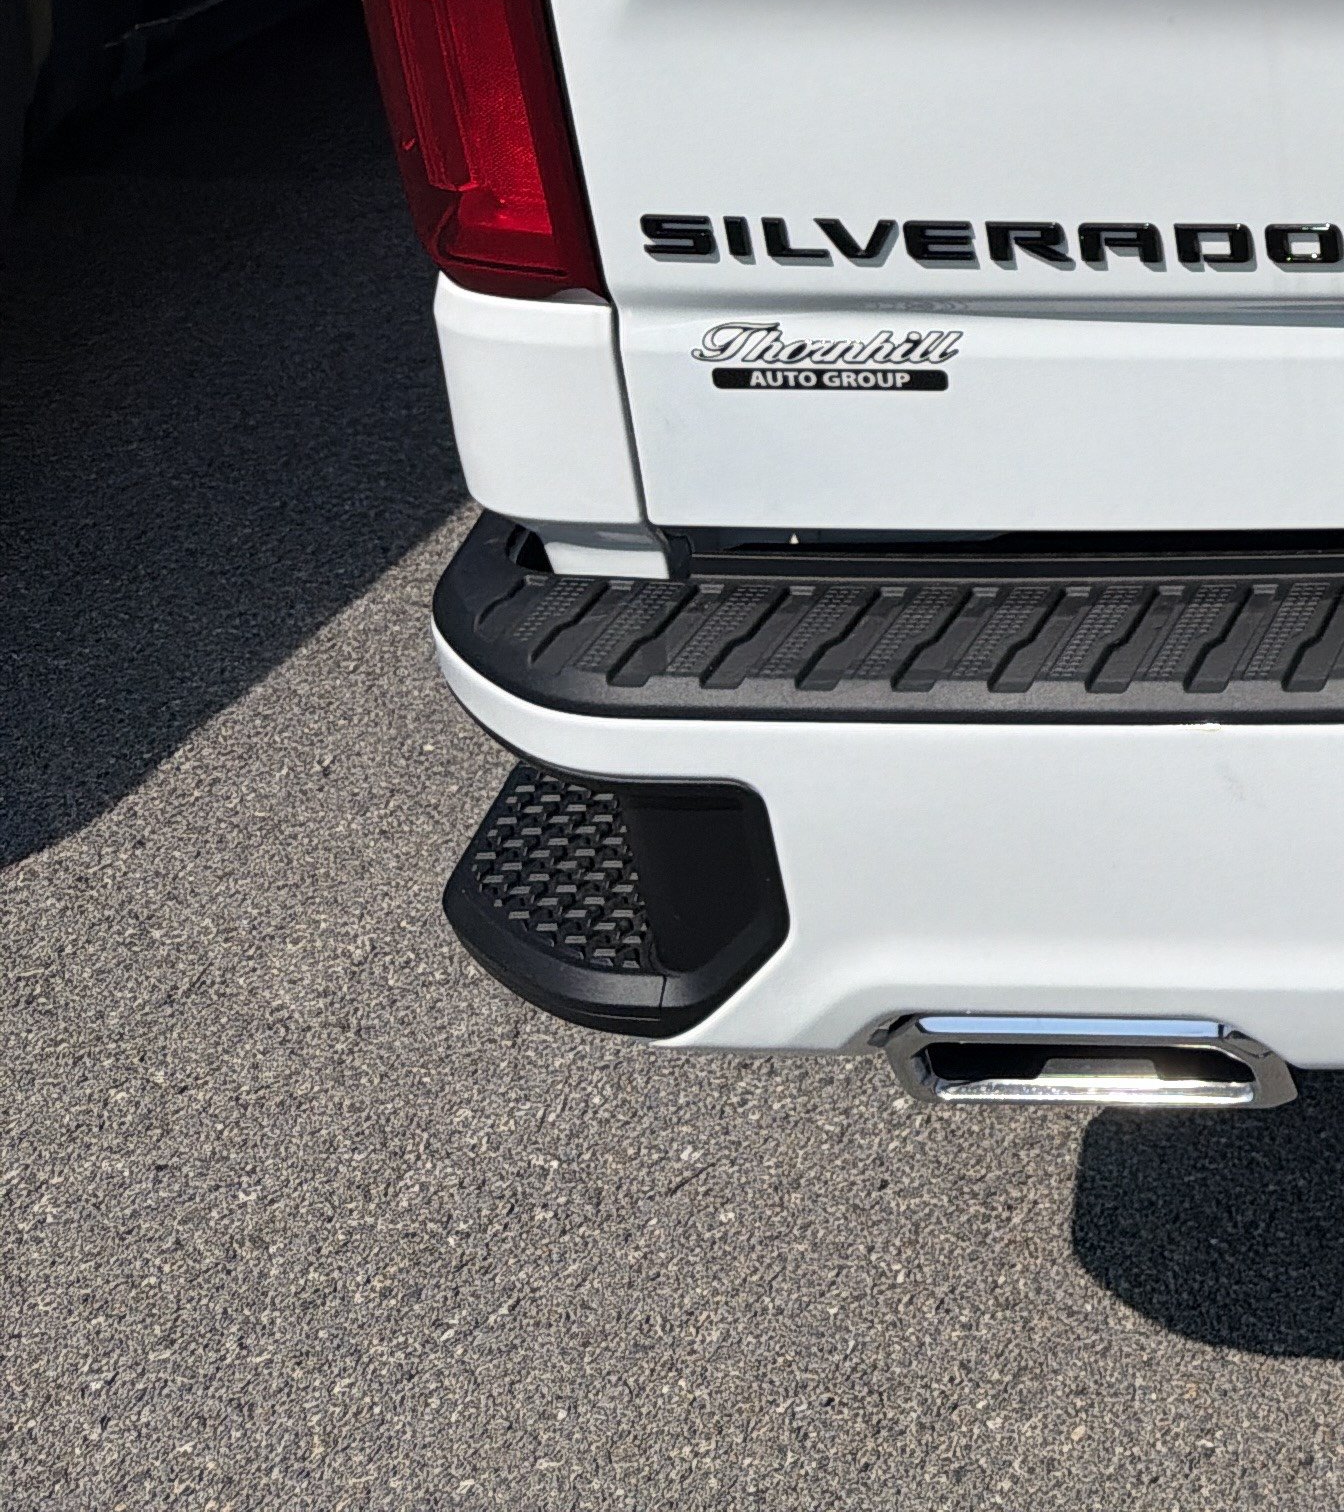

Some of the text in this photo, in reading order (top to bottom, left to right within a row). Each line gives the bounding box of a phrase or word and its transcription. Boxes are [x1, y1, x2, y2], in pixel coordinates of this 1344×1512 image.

[640, 213, 1344, 265] SILVERADO
[691, 322, 963, 364] Thornhill
[750, 371, 911, 388] AUTO GROUP
